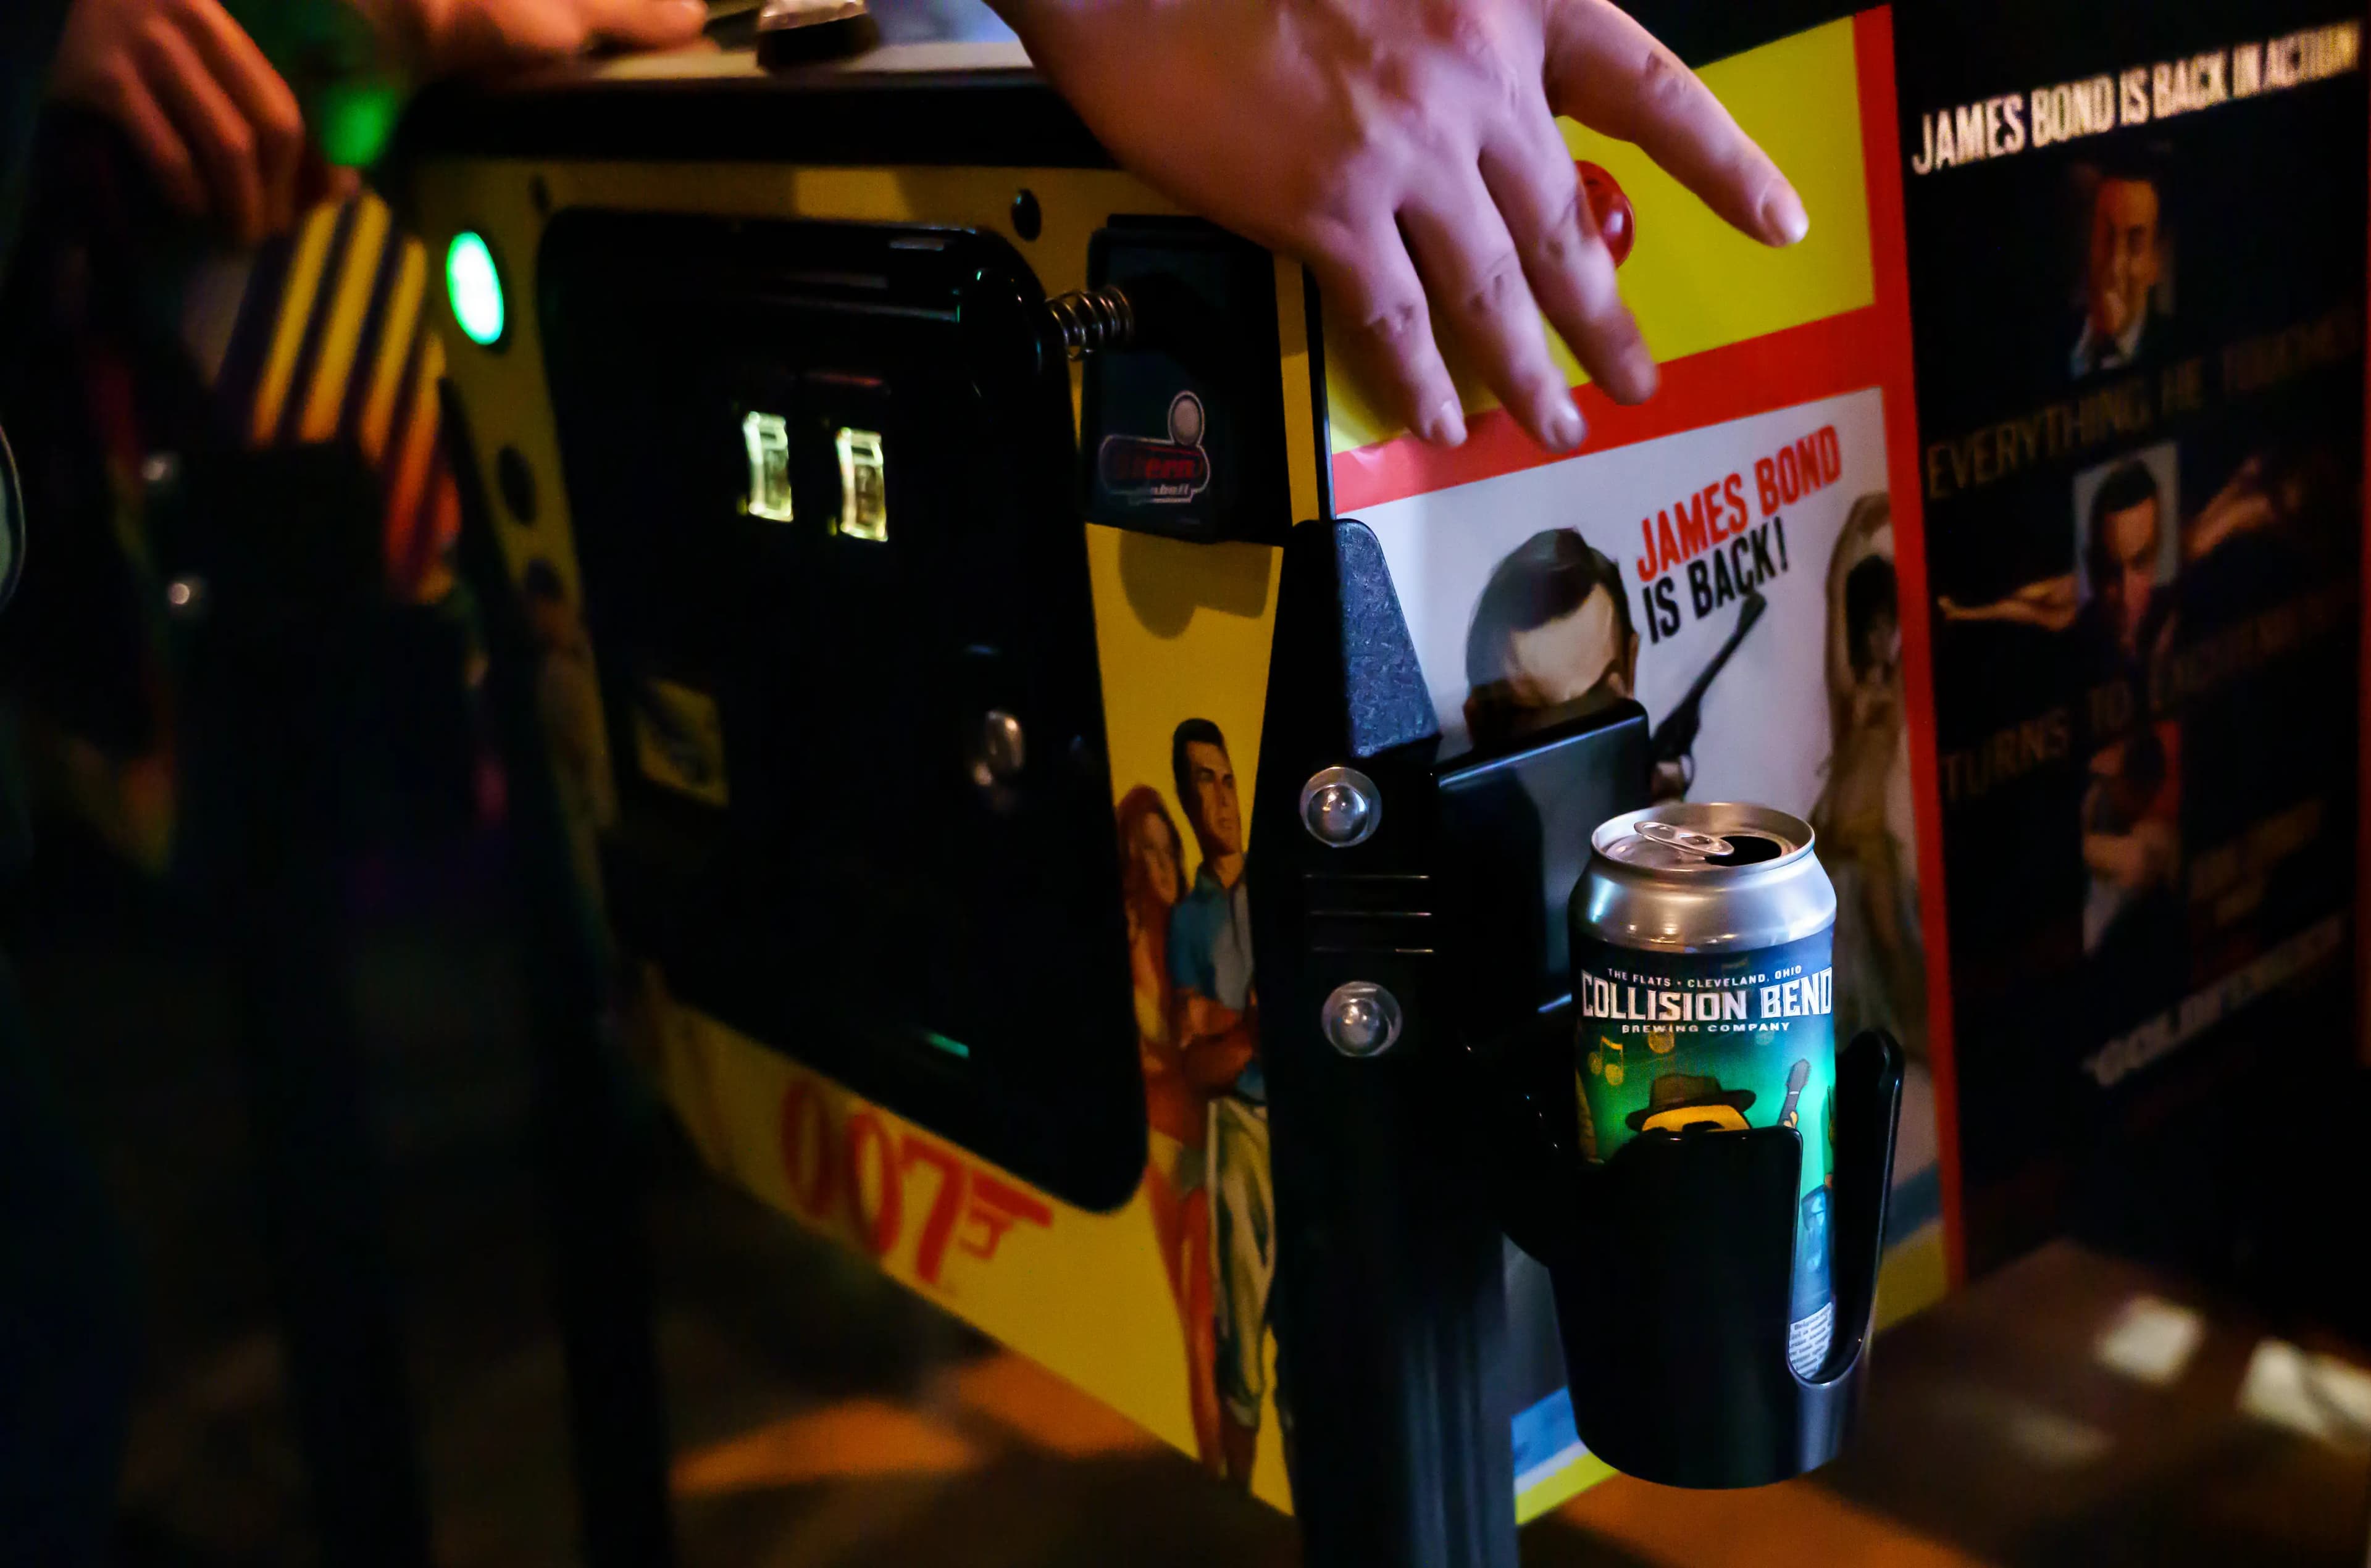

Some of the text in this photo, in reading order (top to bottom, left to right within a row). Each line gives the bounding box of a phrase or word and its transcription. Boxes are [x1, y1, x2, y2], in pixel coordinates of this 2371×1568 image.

[1912, 94, 2025, 175] JAMES
[2031, 72, 2116, 148] BOND
[2120, 66, 2149, 126] IS
[2153, 48, 2227, 119] BACK
[1637, 424, 1842, 583] JAMES BOND
[1642, 516, 1788, 644] IS BACK!
[1581, 966, 1833, 1022] COLLISION BEND
[1607, 964, 1802, 988] THE FLATS CLEVELAND, OHIO
[1621, 1022, 1791, 1034] BREWING COMPANY
[783, 1077, 964, 1285] 007
